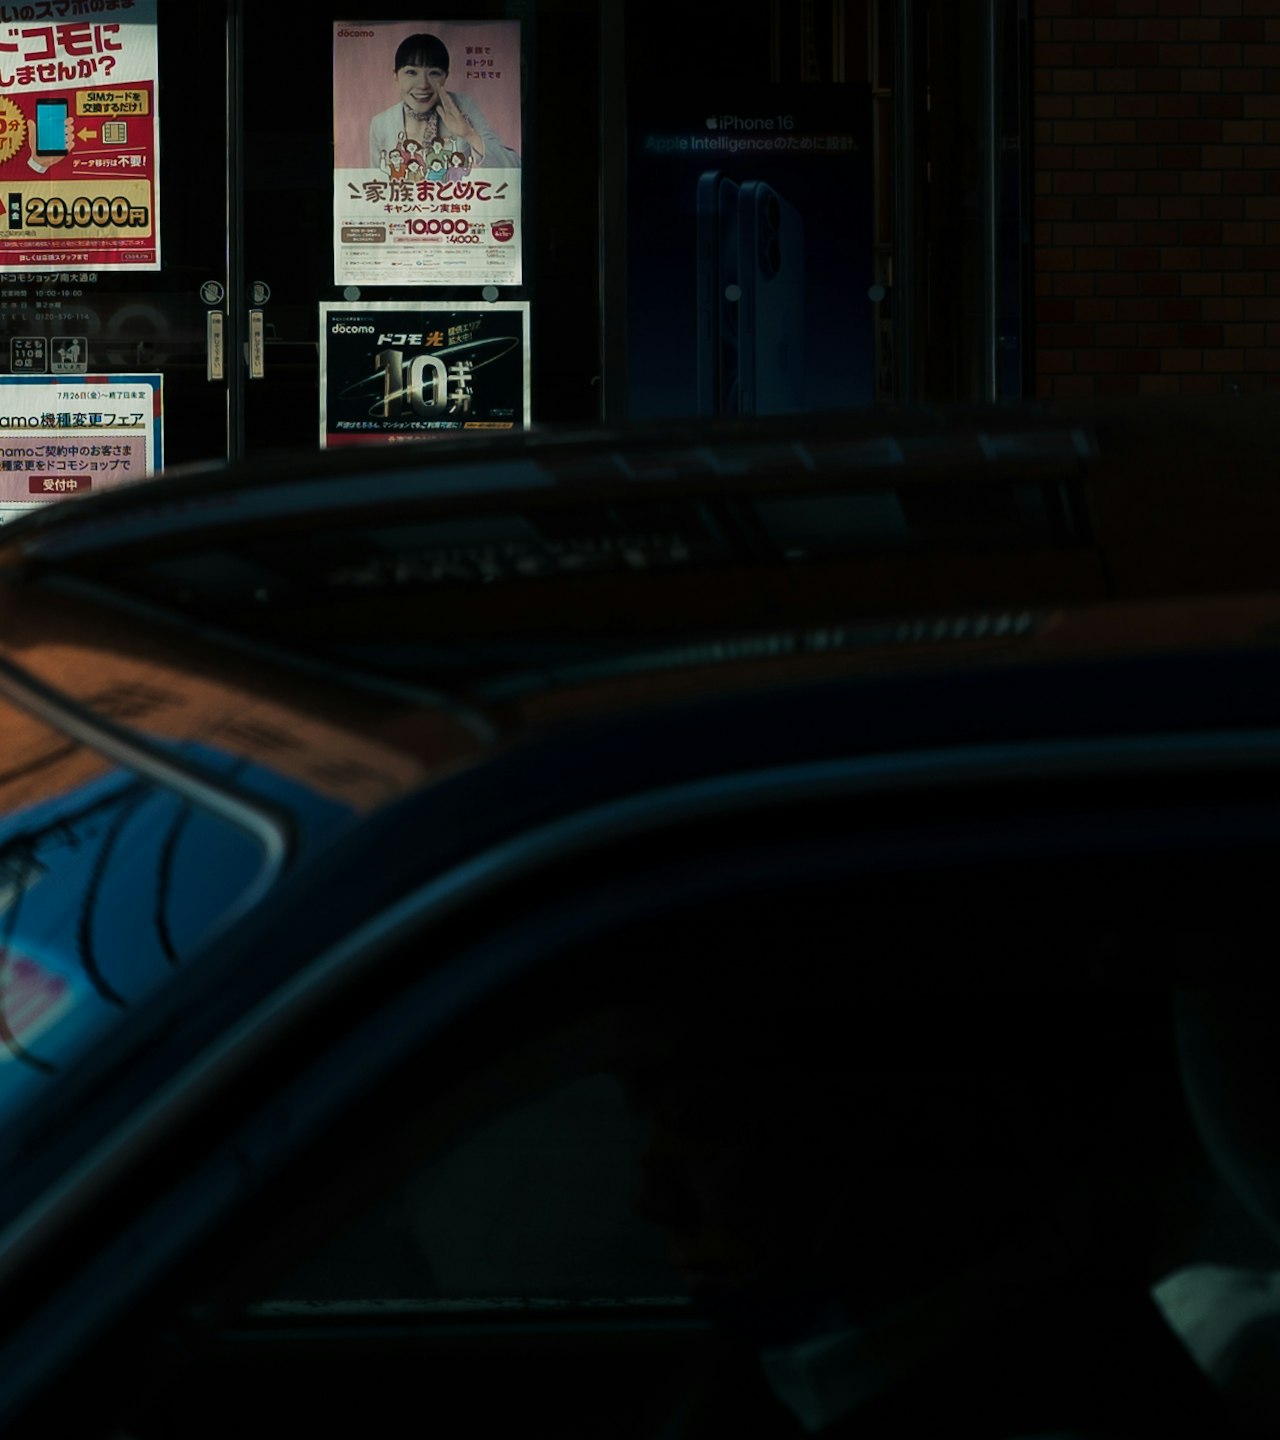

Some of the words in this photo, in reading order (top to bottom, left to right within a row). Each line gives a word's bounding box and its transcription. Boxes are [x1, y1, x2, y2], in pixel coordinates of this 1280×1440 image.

[337, 29, 375, 38] docomo
[719, 114, 774, 130] iPhone
[777, 115, 794, 130] 16
[645, 136, 688, 152] Apple
[362, 179, 491, 203] 家族まとめて
[25, 197, 149, 229] 20,000円
[384, 204, 471, 213] キャンペーン実施中
[331, 323, 375, 334] docomo
[14, 339, 44, 349] こども
[377, 333, 423, 346] ドコモ
[424, 330, 445, 346] 光
[41, 478, 78, 492] 受付中
